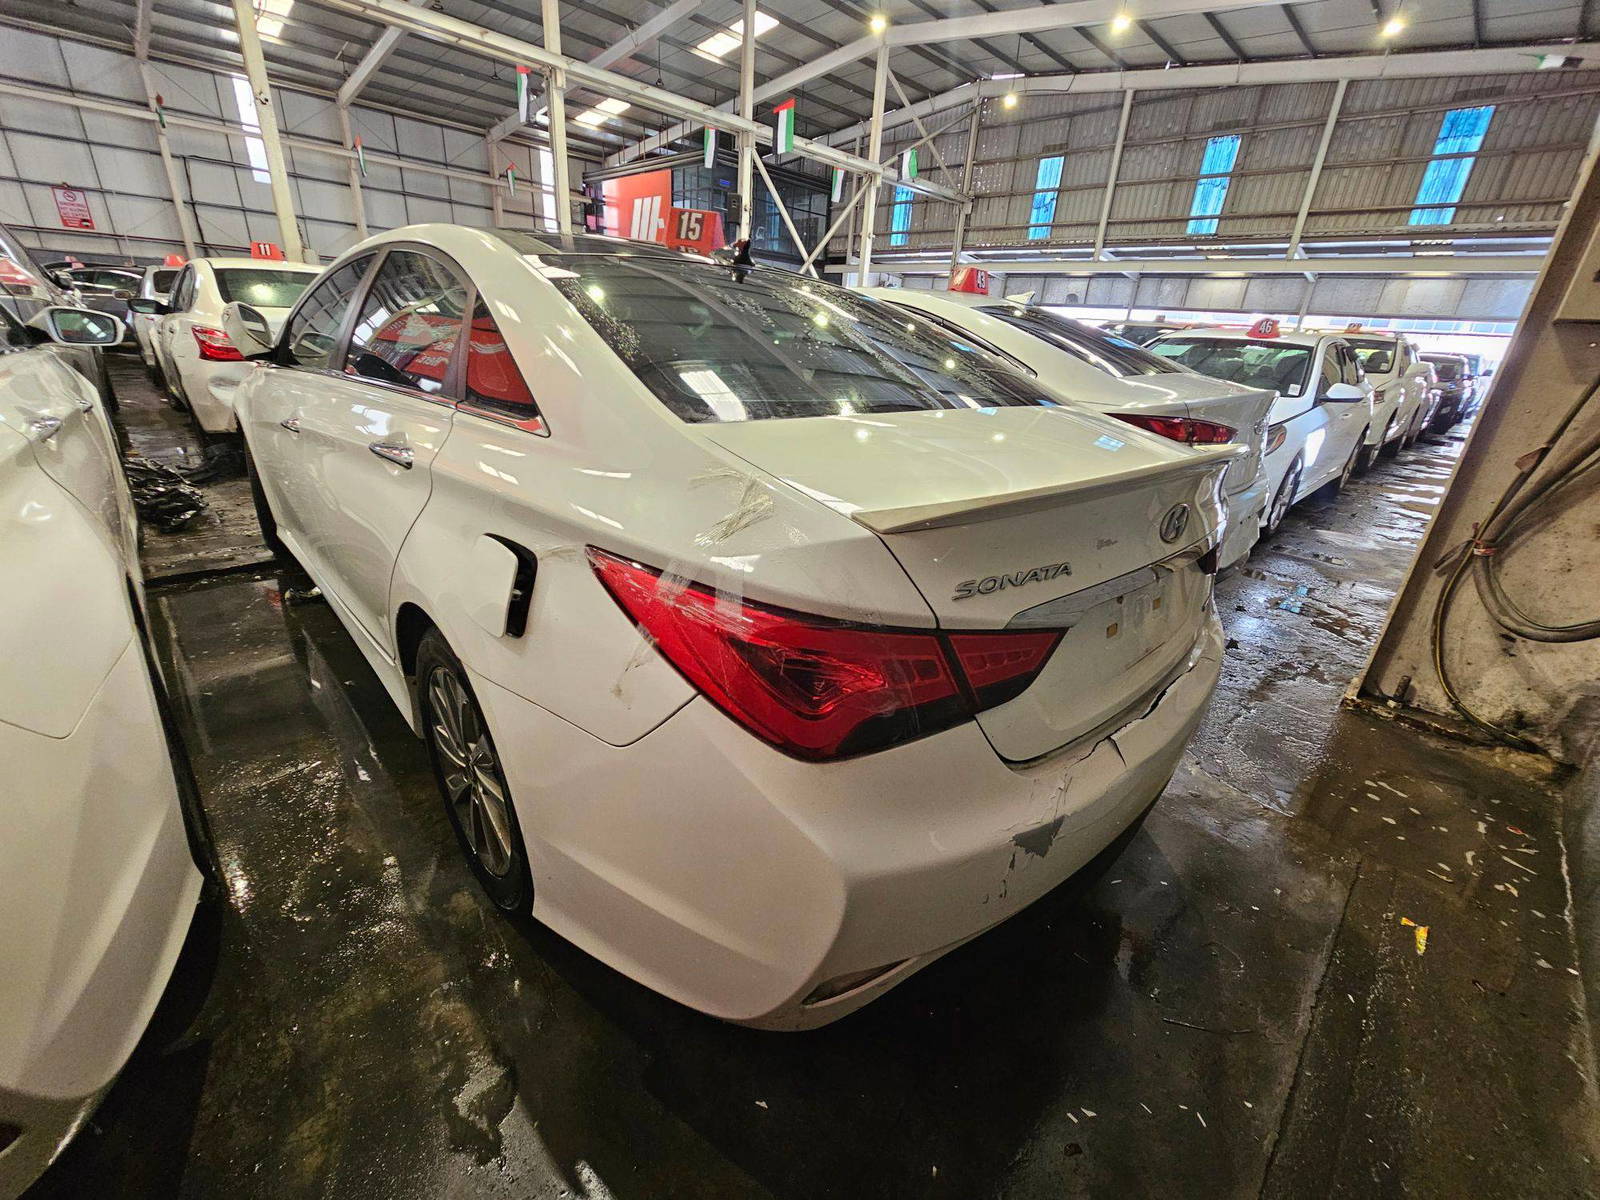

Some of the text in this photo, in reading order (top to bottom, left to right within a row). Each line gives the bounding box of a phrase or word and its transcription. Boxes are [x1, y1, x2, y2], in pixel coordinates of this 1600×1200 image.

[680, 211, 703, 240] 15
[259, 243, 271, 256] 11
[1259, 319, 1273, 334] 46
[952, 561, 1072, 601] SONATA
